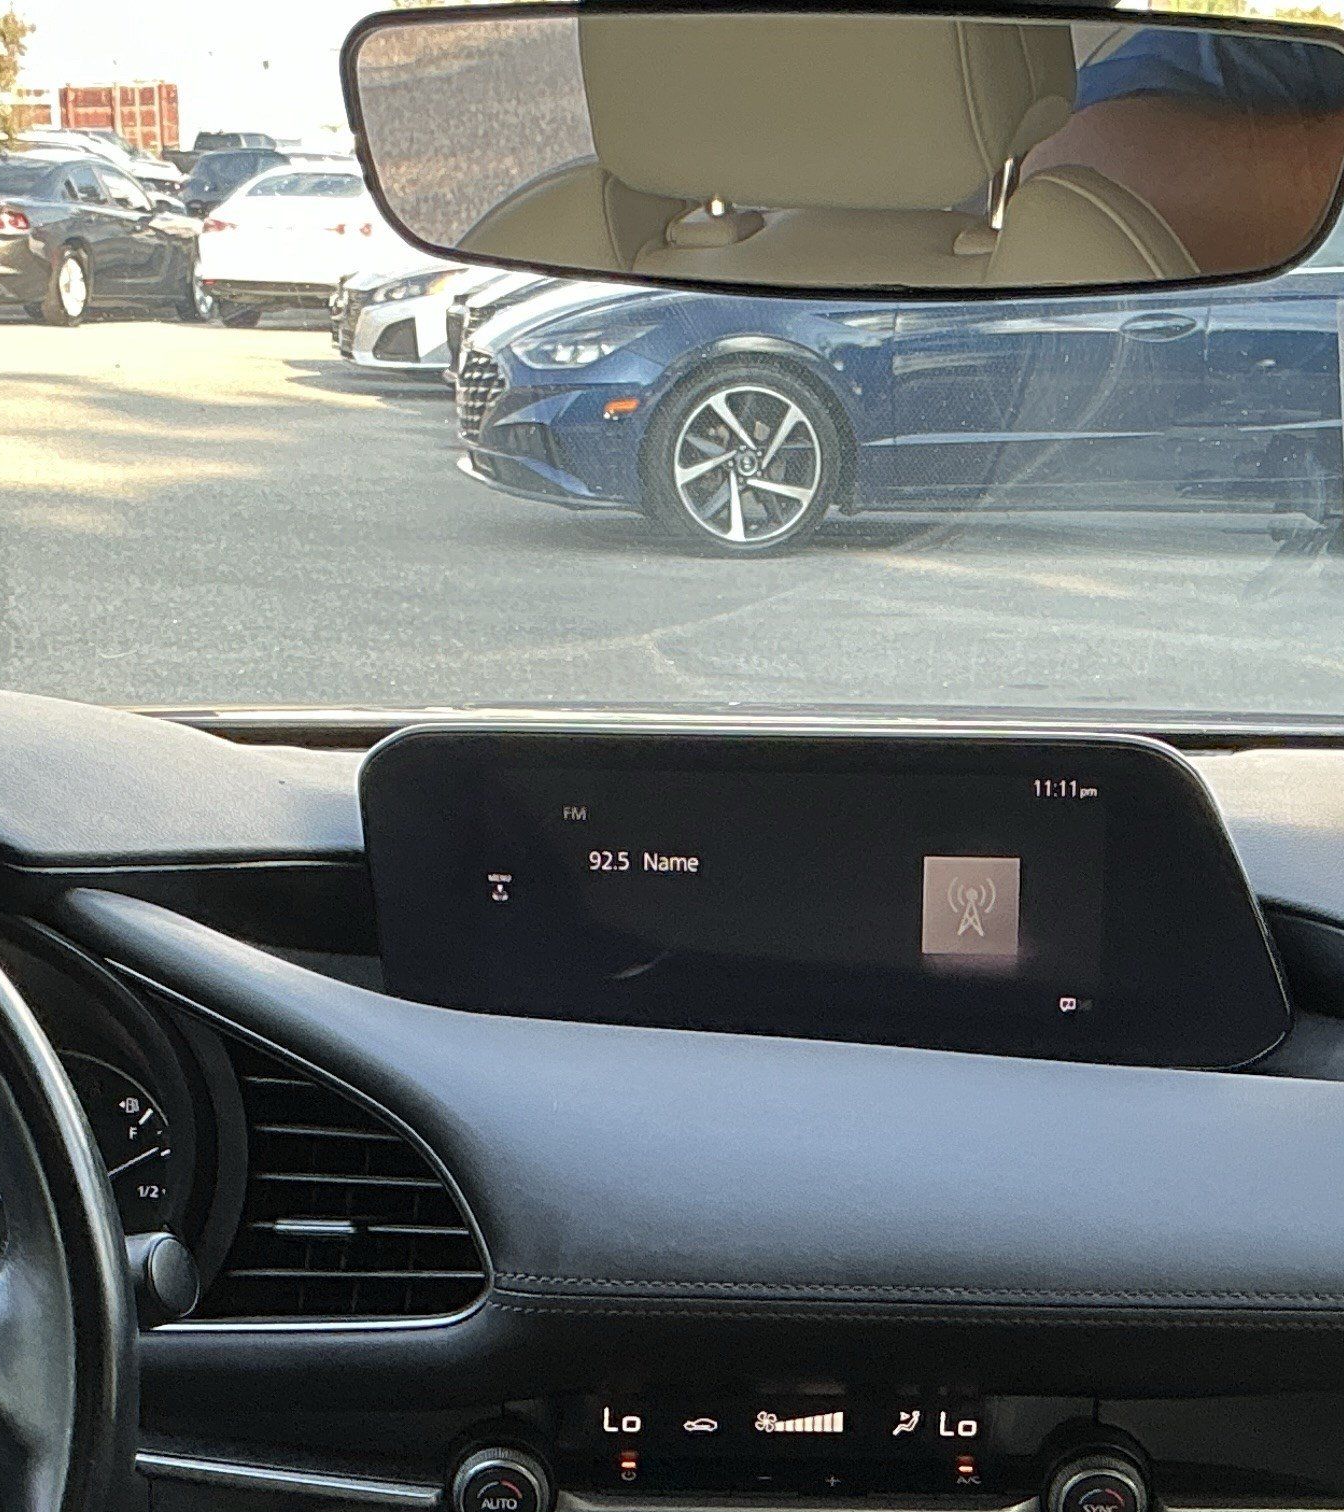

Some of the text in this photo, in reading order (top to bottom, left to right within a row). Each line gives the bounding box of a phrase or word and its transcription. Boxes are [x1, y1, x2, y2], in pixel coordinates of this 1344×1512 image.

[563, 806, 587, 821] FM
[589, 851, 699, 872] 92.5 Name
[129, 1127, 138, 1139] F
[137, 1184, 160, 1198] 1/2
[603, 1406, 642, 1433] Lo
[939, 1410, 978, 1437] Lo
[480, 1497, 518, 1511] AUTO
